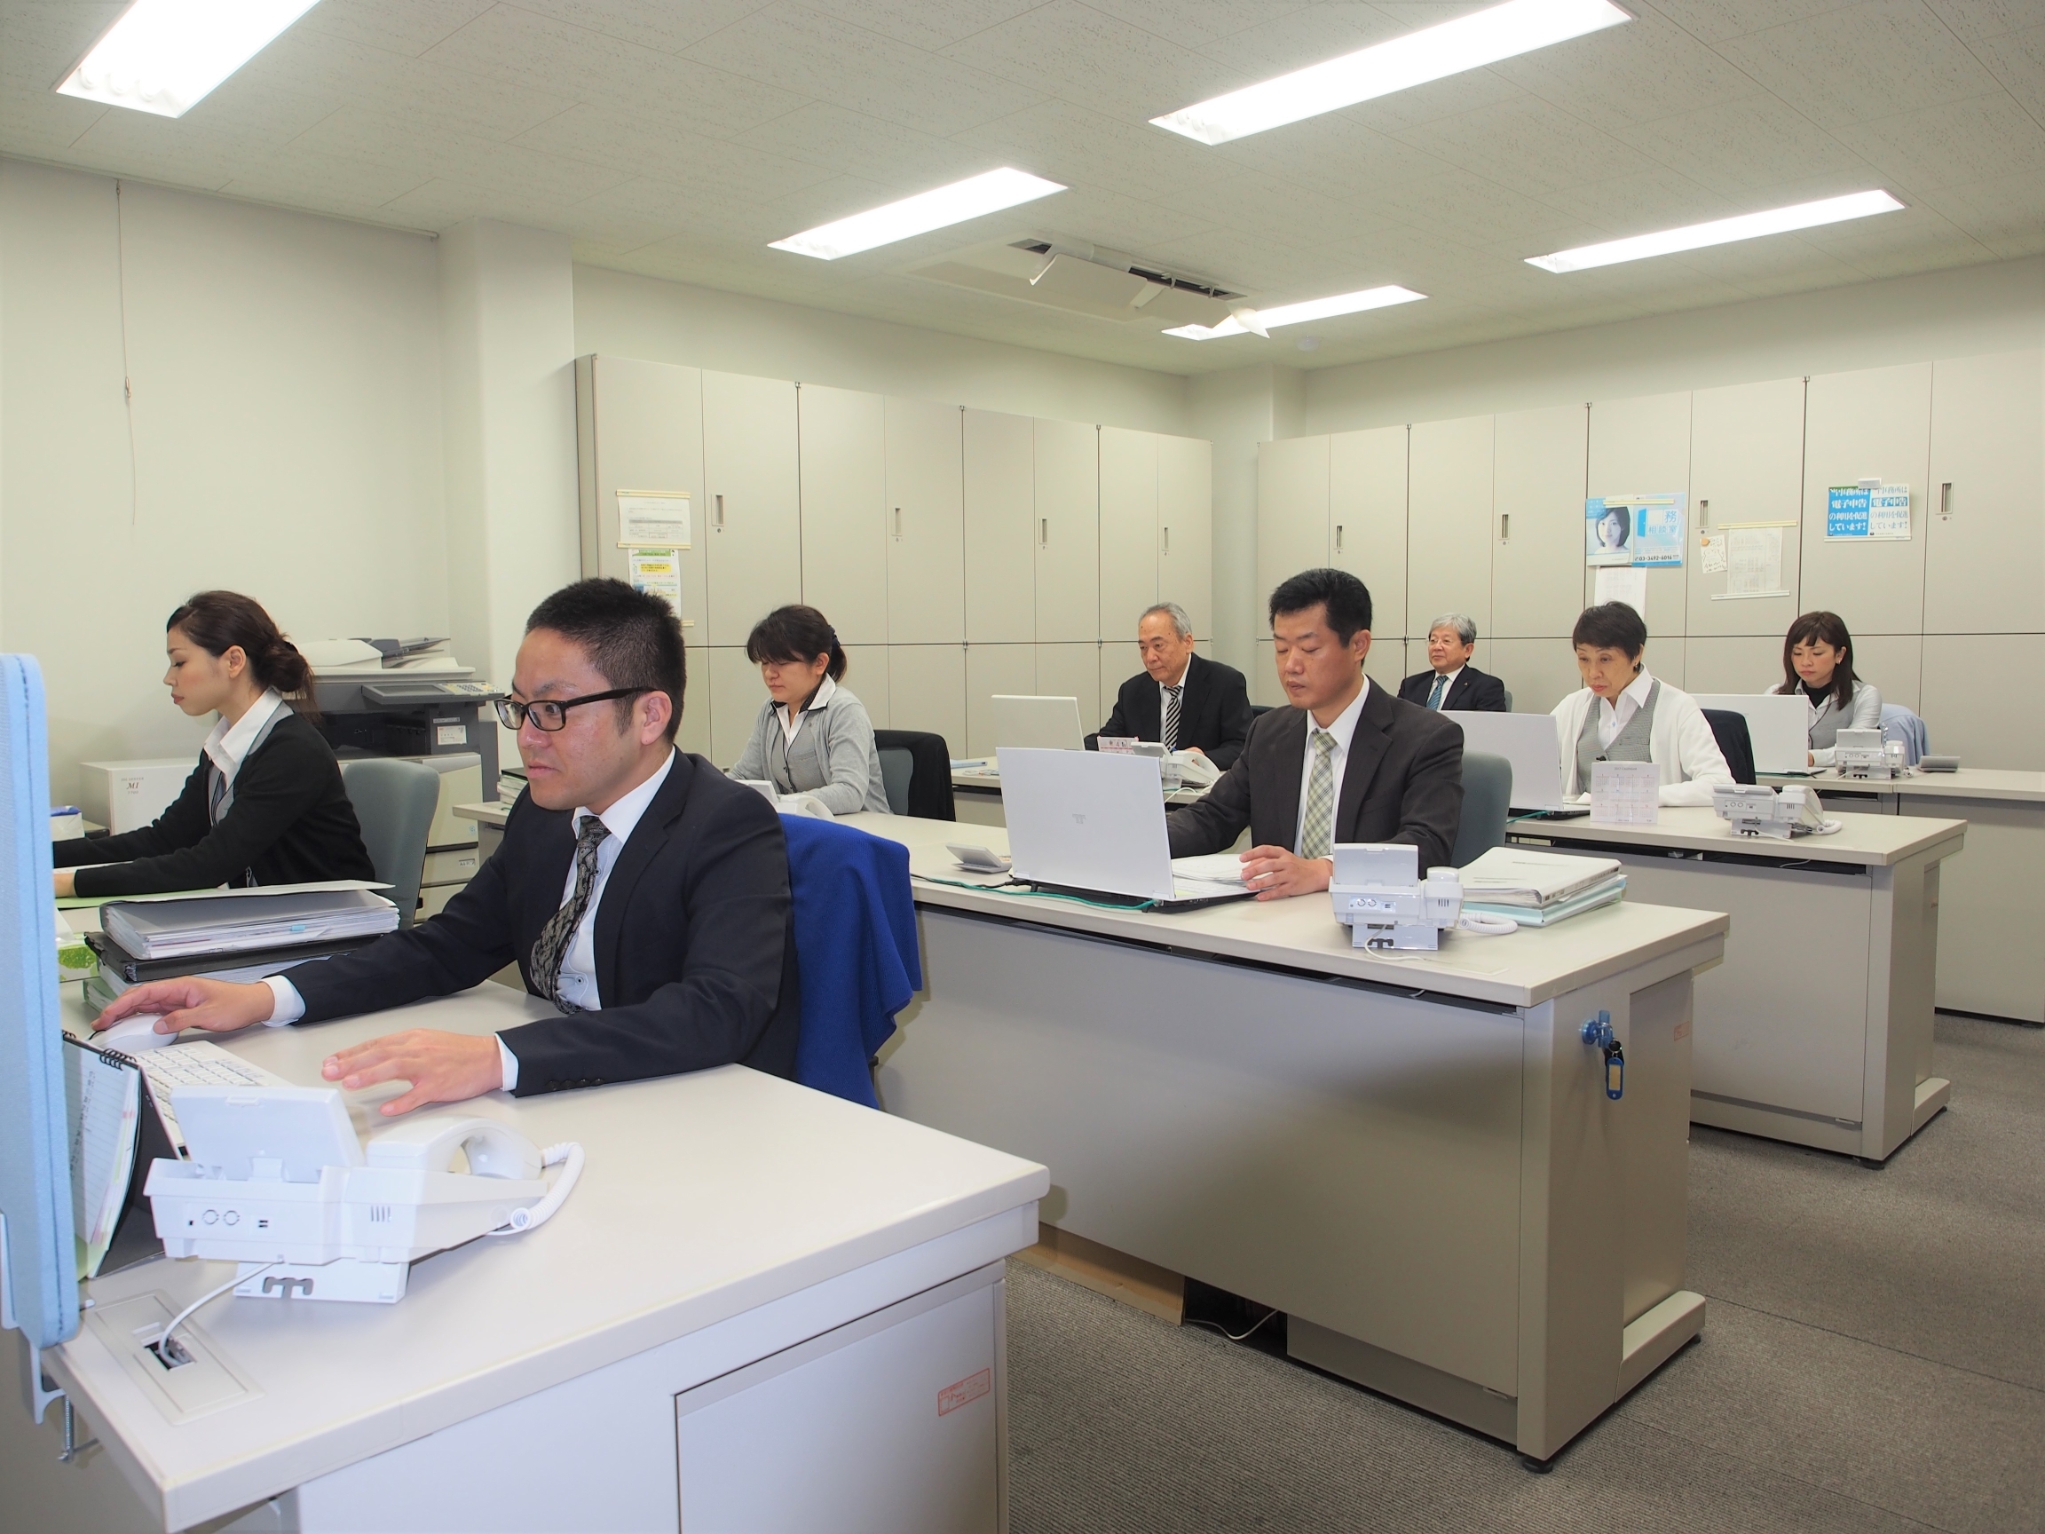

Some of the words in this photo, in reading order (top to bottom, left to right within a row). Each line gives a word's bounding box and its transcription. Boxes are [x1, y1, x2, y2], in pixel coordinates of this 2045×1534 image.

[1831, 498, 1867, 508] 電子申告
[1872, 497, 1907, 506] 電子申告
